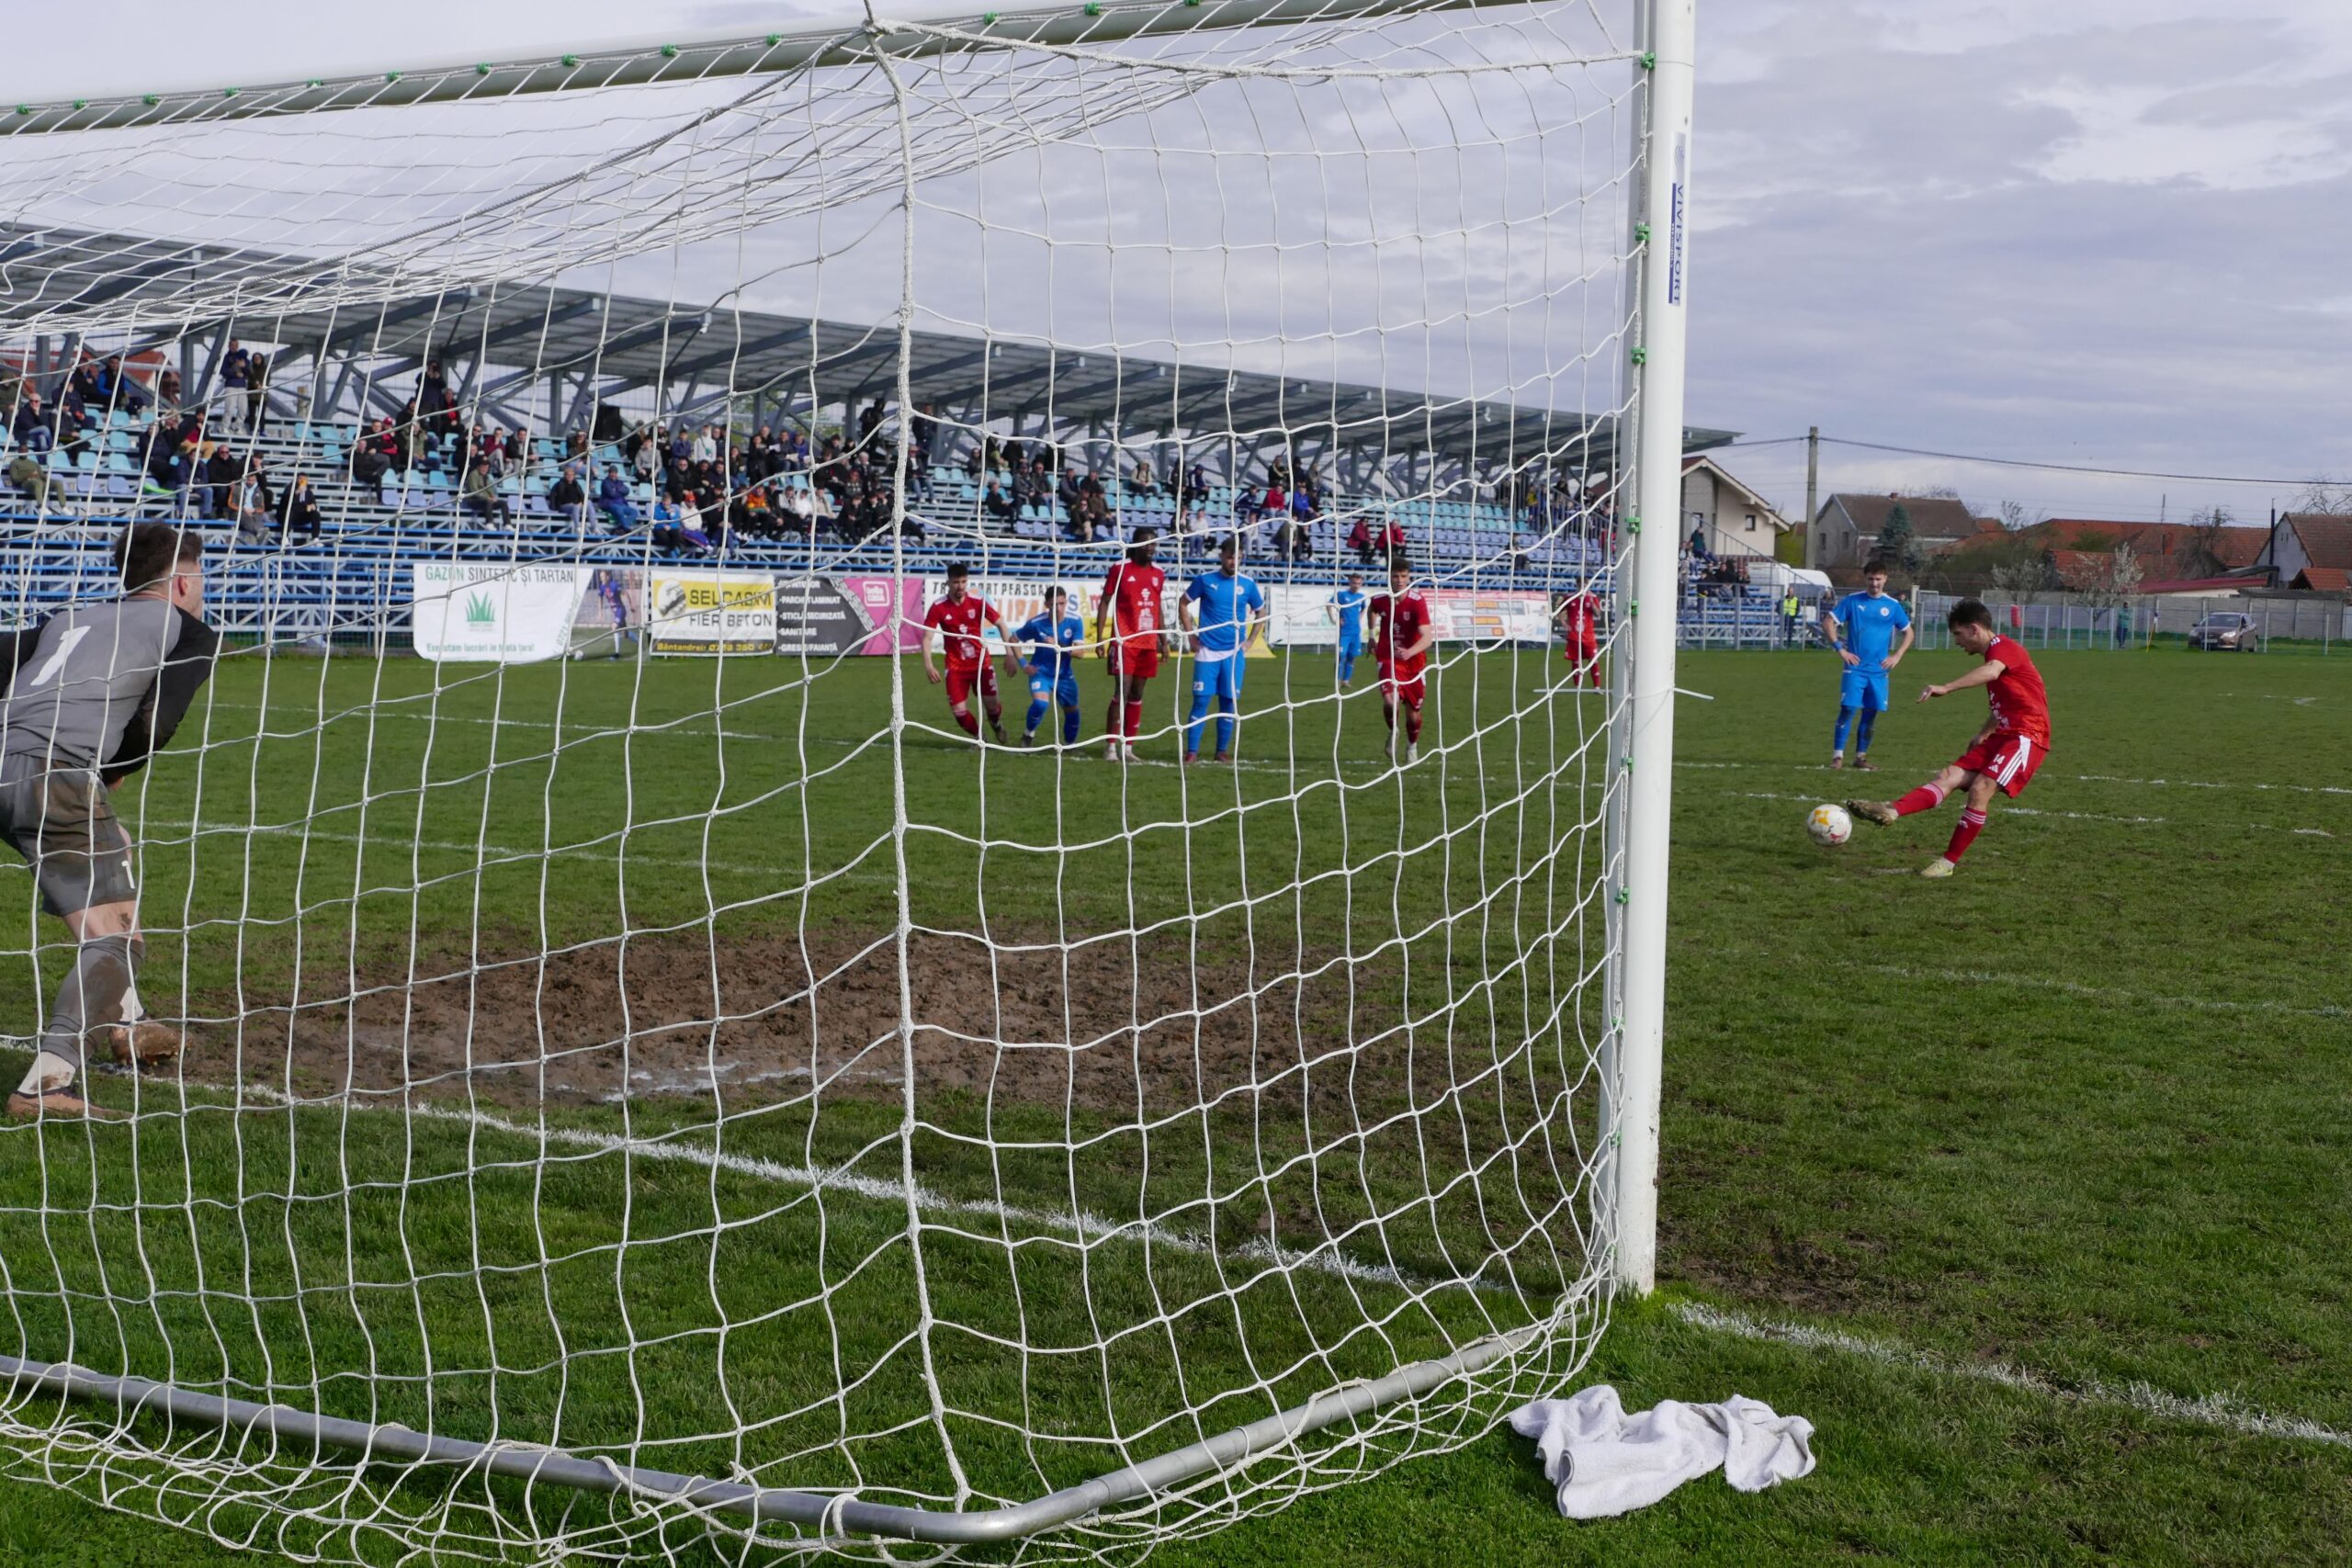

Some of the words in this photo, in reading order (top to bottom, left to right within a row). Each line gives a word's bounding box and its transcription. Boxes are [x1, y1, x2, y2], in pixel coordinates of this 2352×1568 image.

[1674, 185, 1683, 301] VIVISPORT
[469, 567, 517, 582] SINTETC
[535, 570, 574, 582] TARTAN
[690, 613, 719, 626] FIER
[727, 613, 772, 626] BETON
[30, 626, 92, 686] 1
[121, 860, 136, 890] 1
